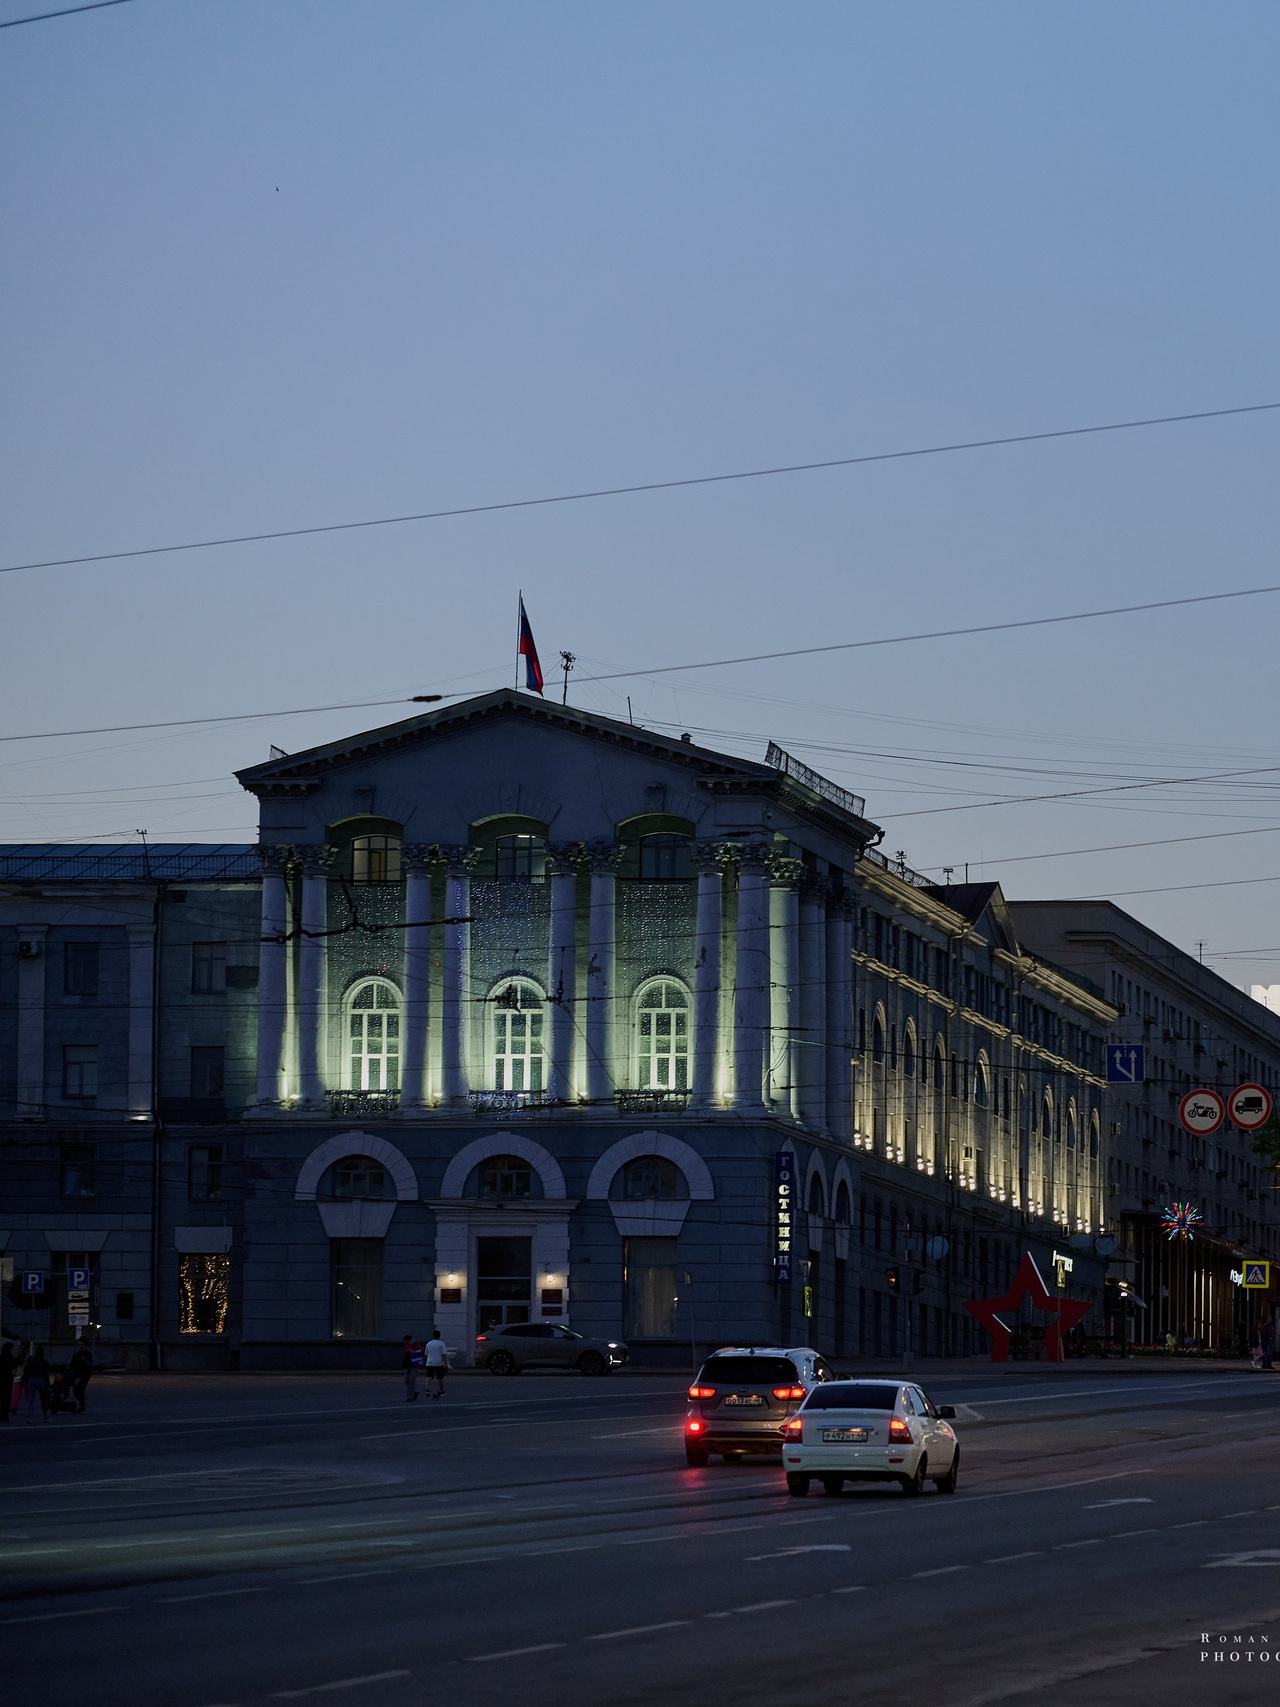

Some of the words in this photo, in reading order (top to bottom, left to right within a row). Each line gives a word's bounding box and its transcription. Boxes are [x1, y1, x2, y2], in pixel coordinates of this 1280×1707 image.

[778, 1156, 791, 1280] ГОСТИНИЦА
[27, 1273, 40, 1290] P
[73, 1271, 85, 1288] P
